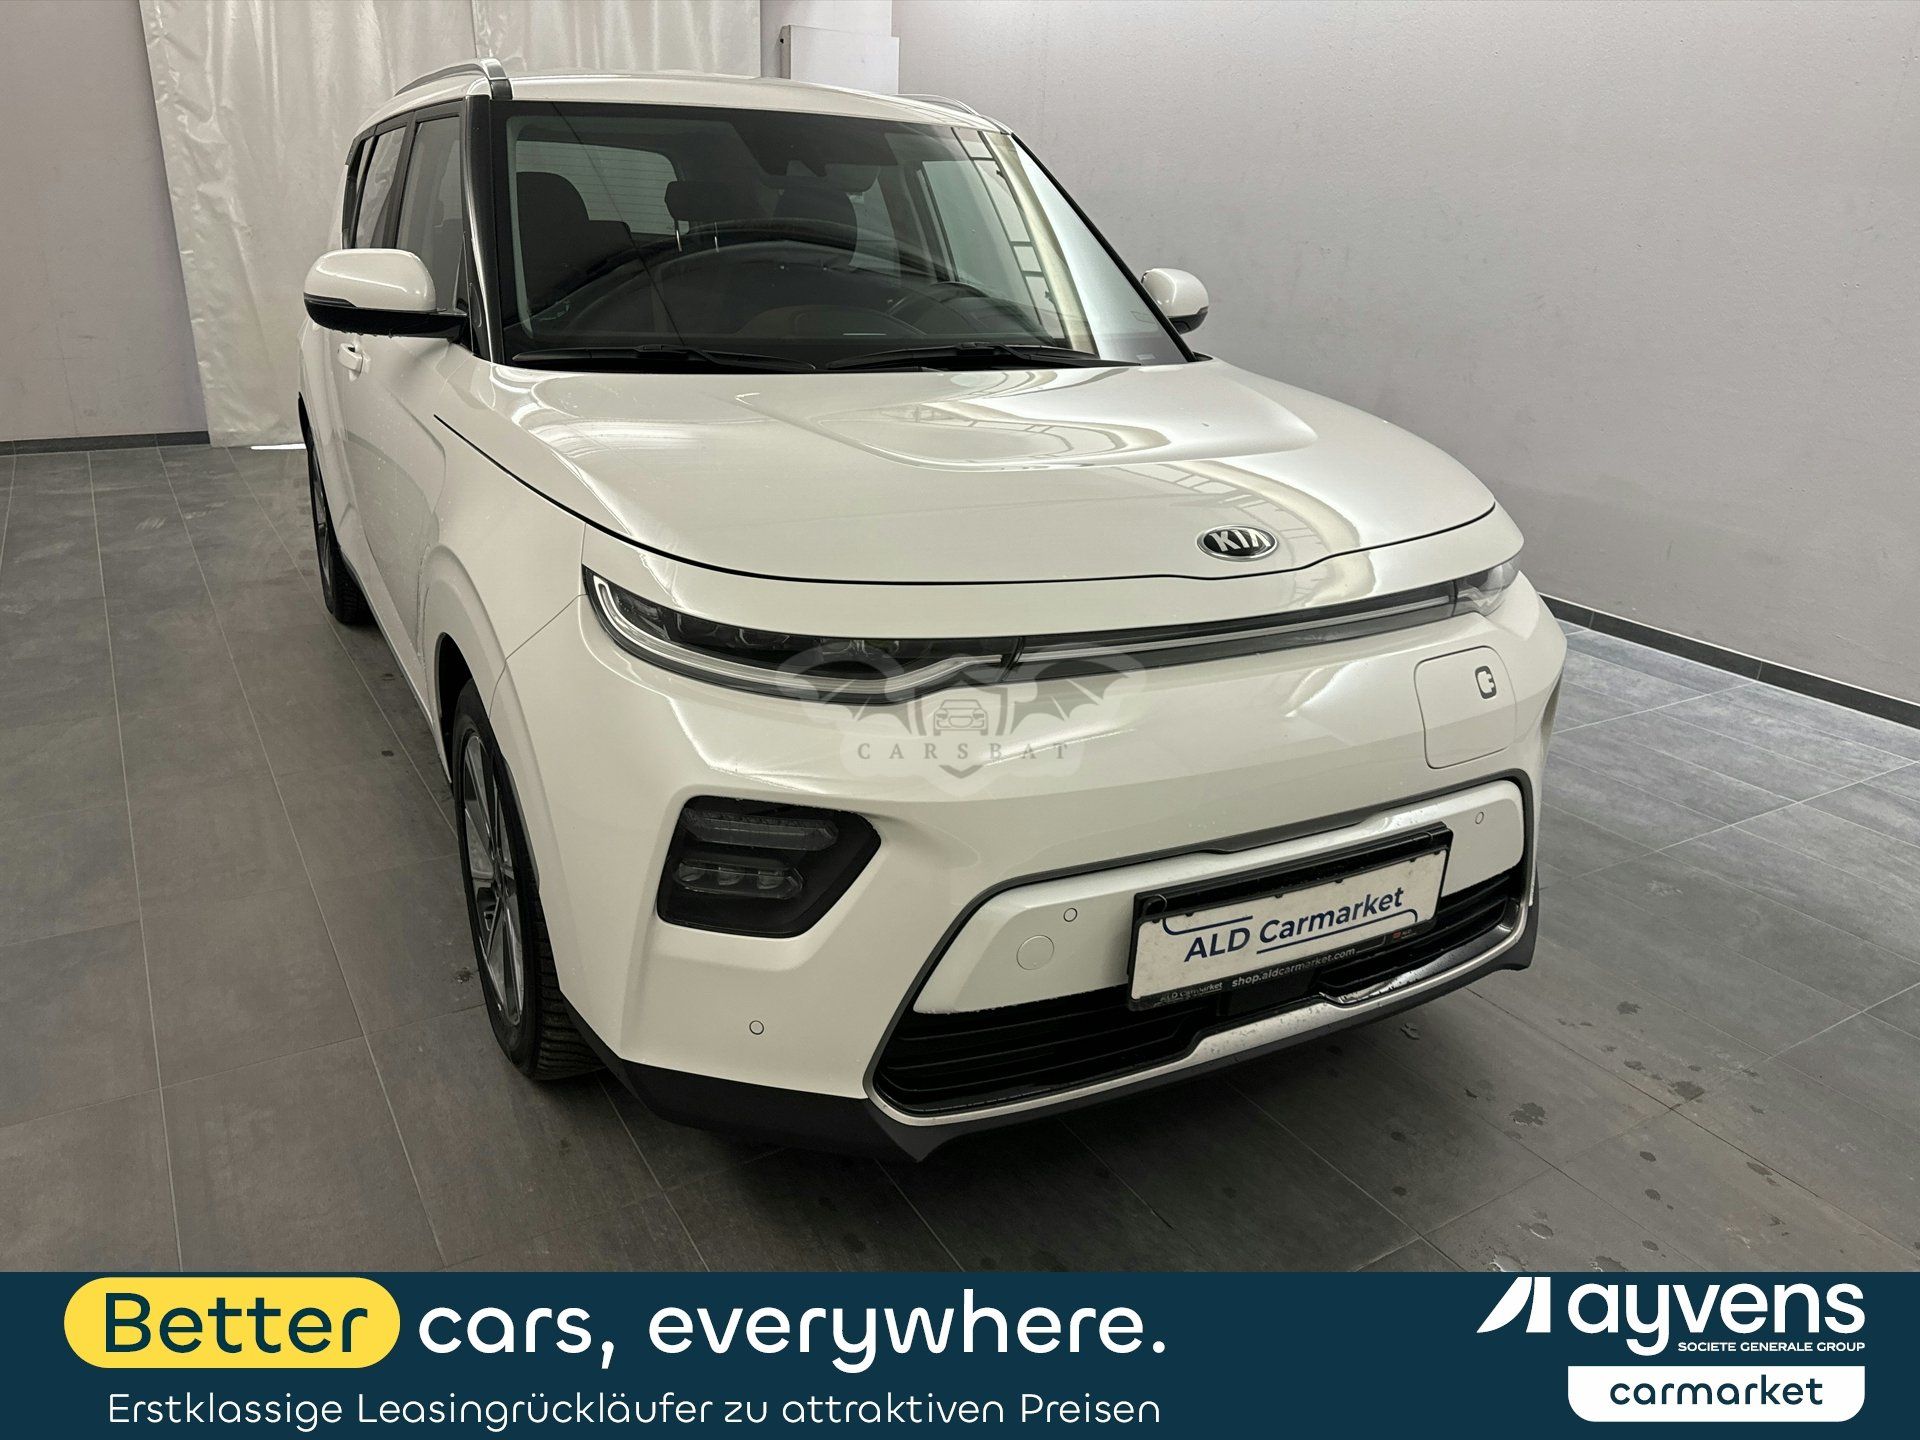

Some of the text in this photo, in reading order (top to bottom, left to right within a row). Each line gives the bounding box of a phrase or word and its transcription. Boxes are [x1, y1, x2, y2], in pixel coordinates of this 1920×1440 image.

[1208, 528, 1271, 552] KIA
[1183, 886, 1405, 963] ALD Carmarket
[1231, 947, 1356, 988] shop.aldcarmarket.com
